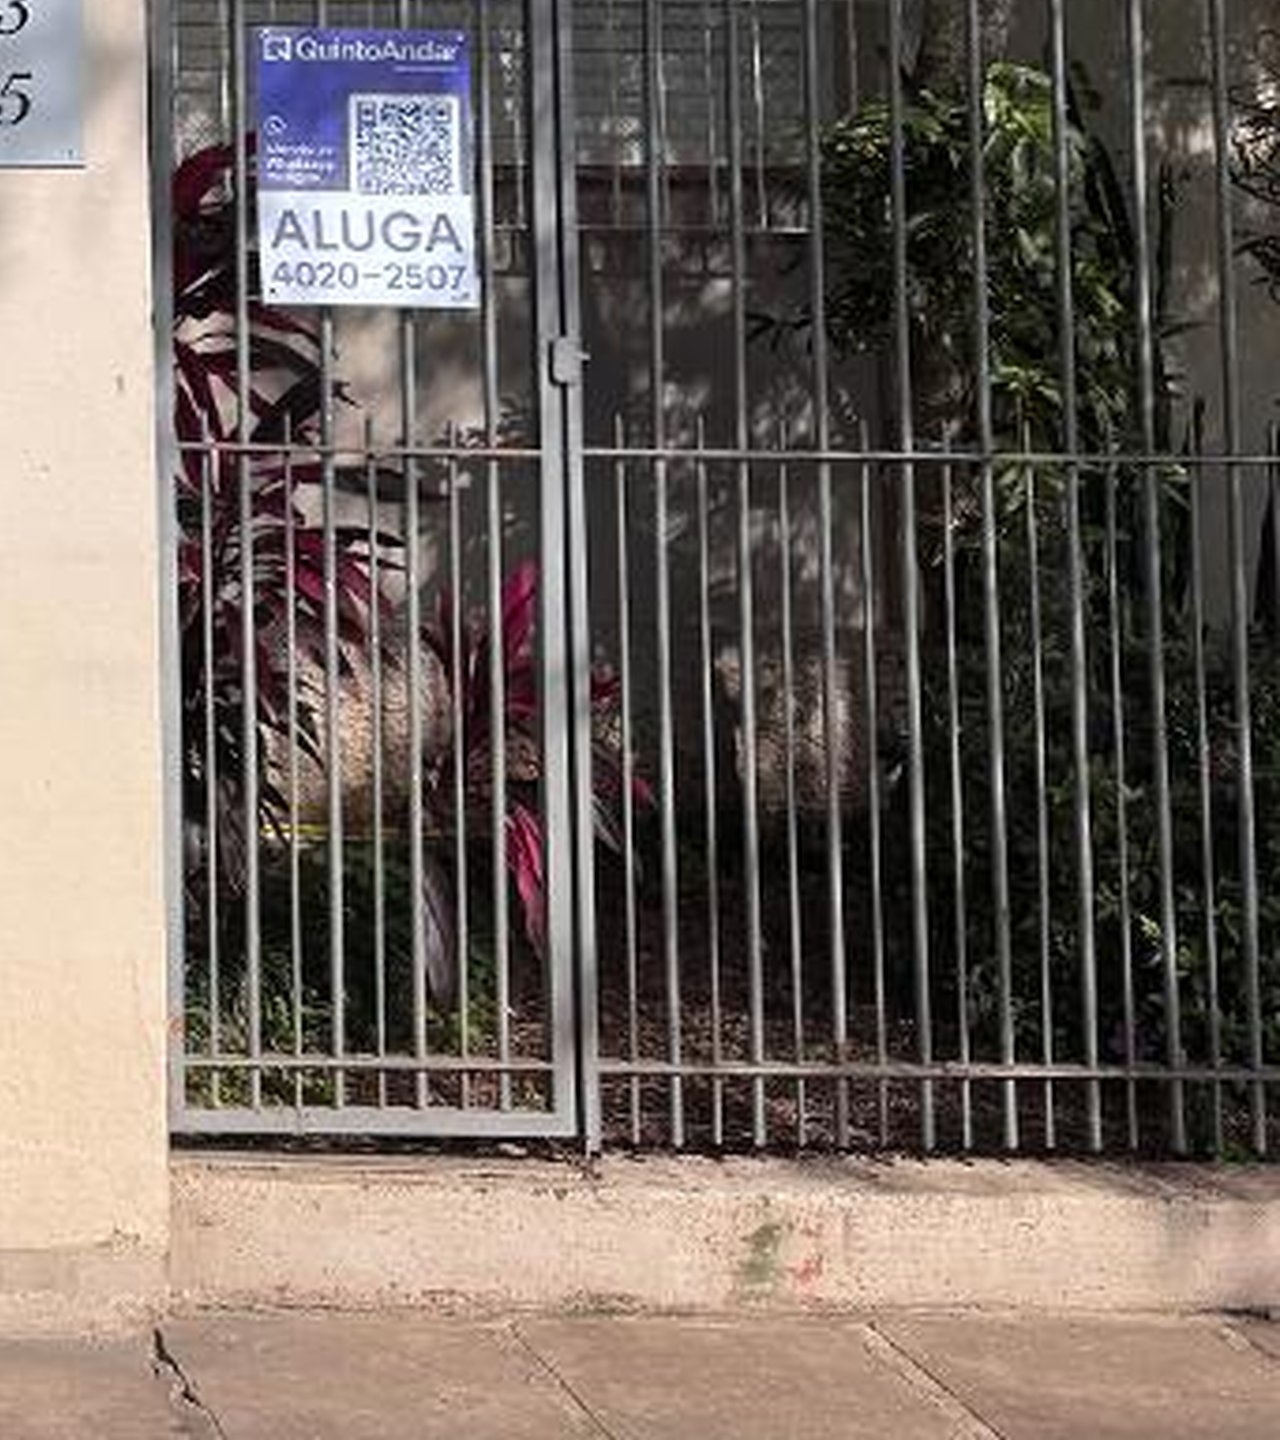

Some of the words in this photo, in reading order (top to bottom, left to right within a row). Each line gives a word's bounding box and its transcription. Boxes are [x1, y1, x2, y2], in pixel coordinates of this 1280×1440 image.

[295, 35, 457, 61] QuintoAndar
[270, 210, 464, 253] ALUGA
[272, 261, 467, 291] 4020-2507
